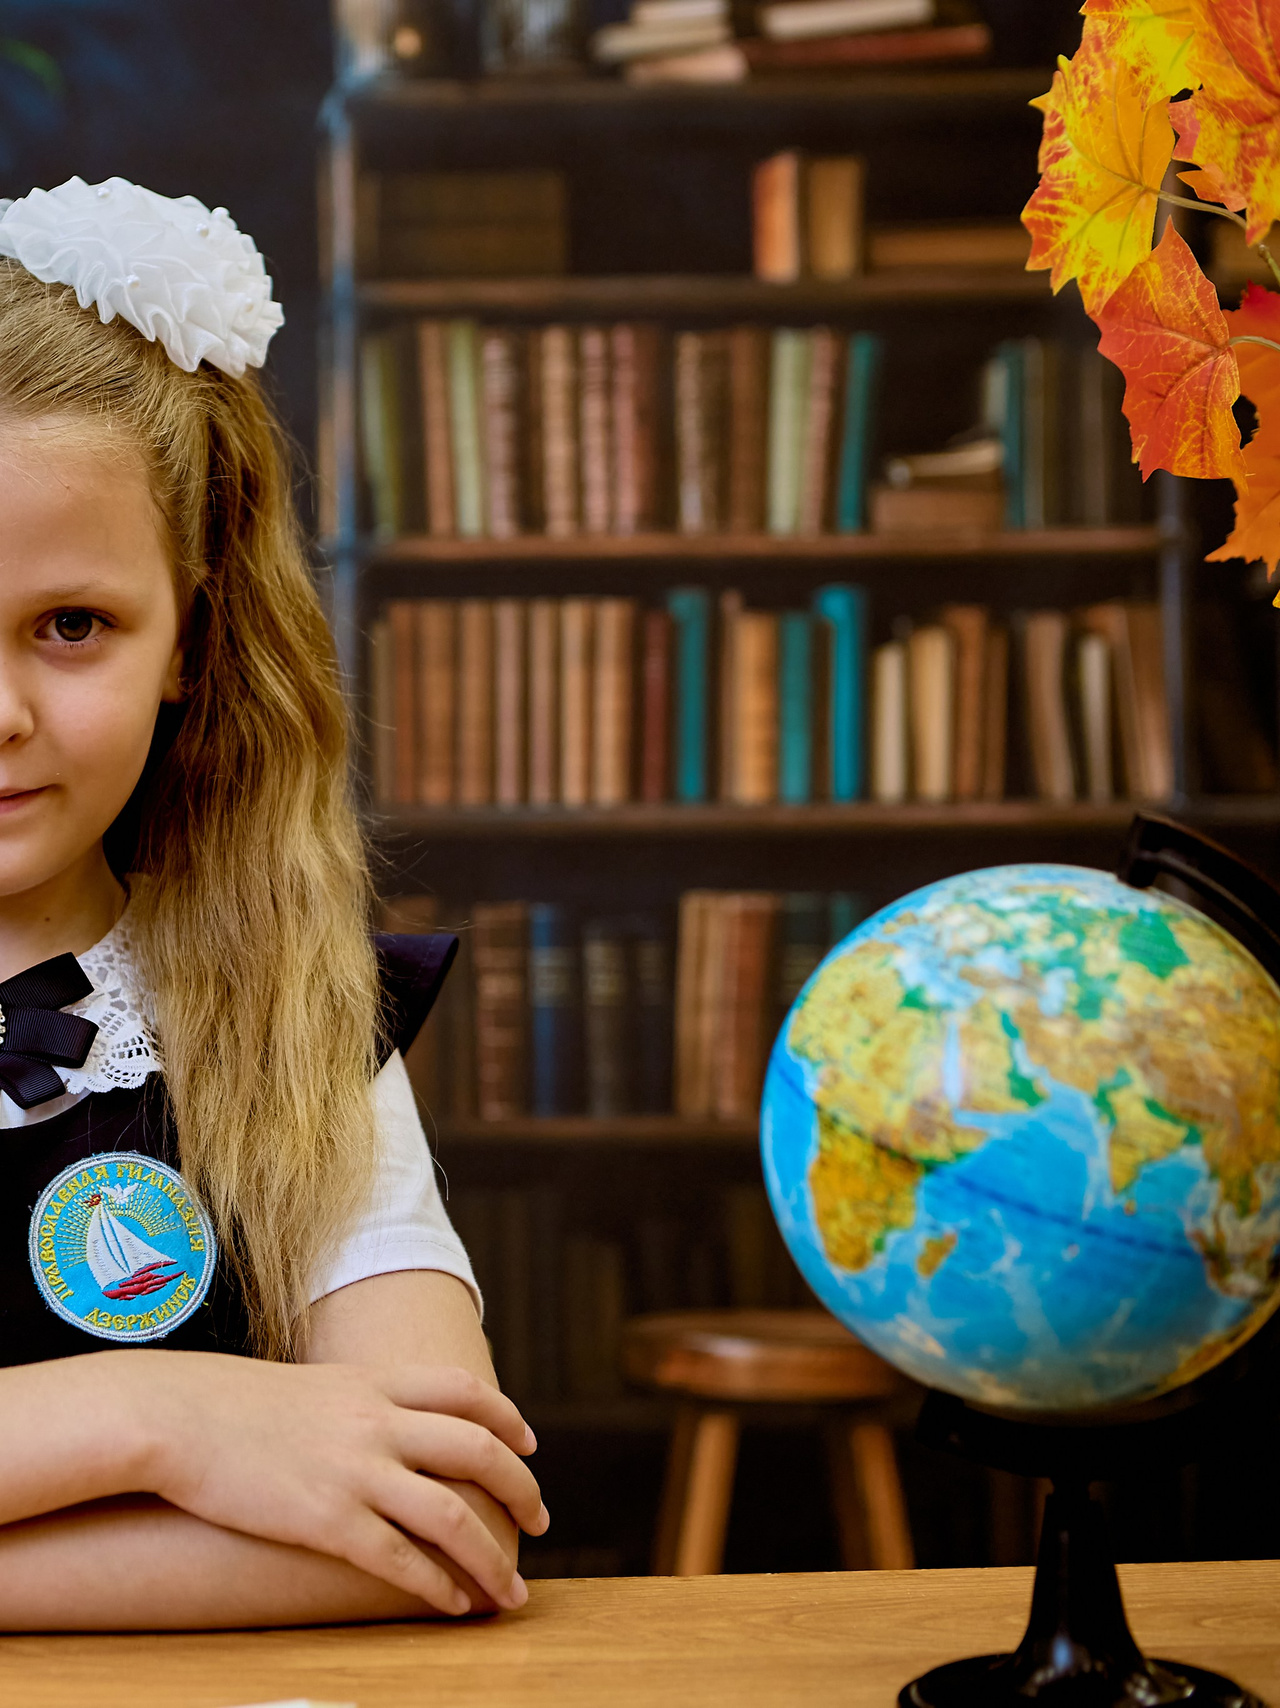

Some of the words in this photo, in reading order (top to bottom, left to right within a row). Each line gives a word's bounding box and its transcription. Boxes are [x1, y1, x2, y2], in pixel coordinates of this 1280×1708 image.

[39, 1165, 110, 1301] ПРАВОСЛАВНАЯ
[116, 1163, 205, 1252] ГИМНАЗИЯ
[83, 1272, 197, 1331] ДЗЕРЖИНСК
